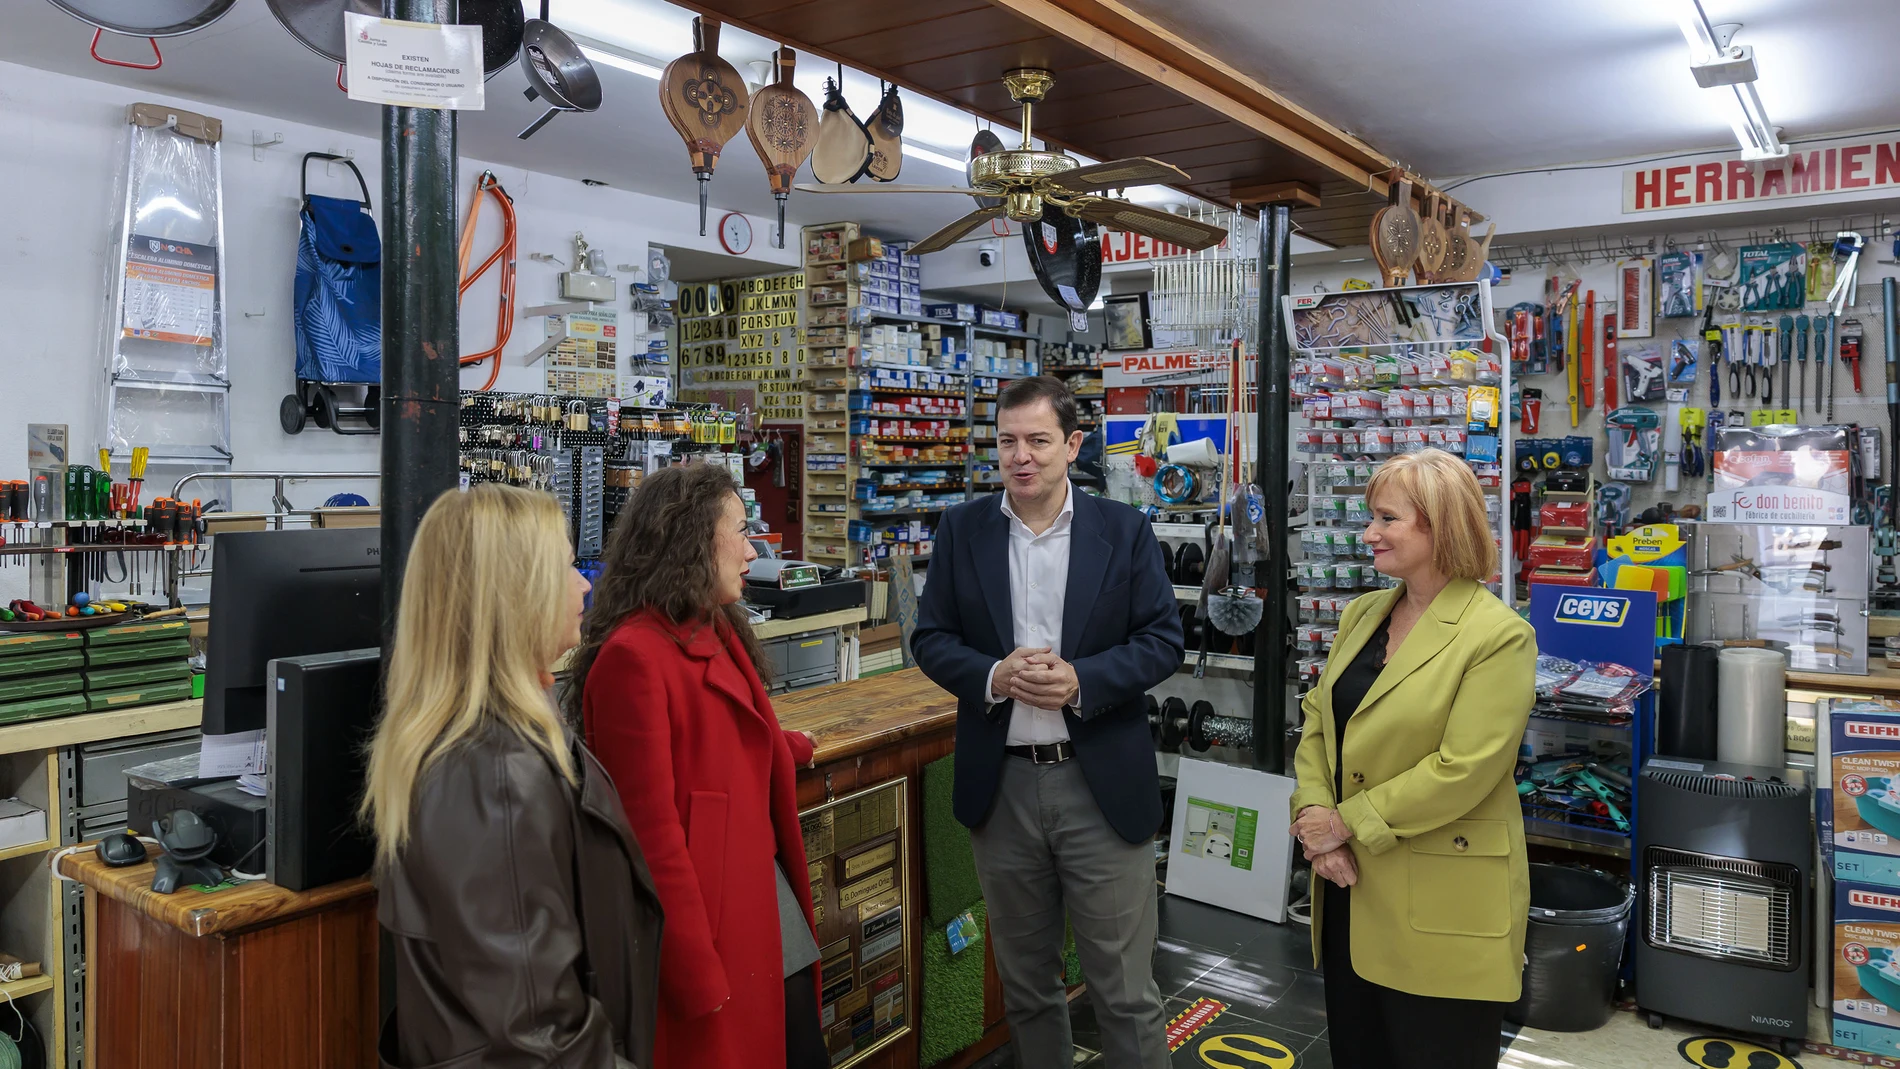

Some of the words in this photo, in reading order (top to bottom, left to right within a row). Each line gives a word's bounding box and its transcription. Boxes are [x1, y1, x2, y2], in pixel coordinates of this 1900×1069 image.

[402, 54, 430, 62] EXISTEN
[371, 61, 393, 69] HOJAS
[404, 65, 460, 74] RECLAMACIONES
[372, 76, 400, 84] DISPOSICIÓN
[1635, 142, 1900, 210] HERRAMIEN
[131, 252, 157, 262] ESCALERA
[158, 257, 183, 266] ALUMINIO
[934, 308, 952, 316] TESA
[1756, 494, 1778, 509] don
[1784, 494, 1823, 510] benito
[1746, 511, 1768, 520] fábrica
[1632, 537, 1662, 546] Preben
[1562, 598, 1619, 620] ceys
[1841, 757, 1870, 766] CLEAN
[1872, 759, 1900, 768] TWIST
[1837, 862, 1859, 872] SET
[1844, 926, 1874, 936] CLEAN
[1182, 1003, 1215, 1029] SEGURIDAD
[1751, 1015, 1790, 1027] NIAROS
[1835, 1030, 1858, 1040] SET
